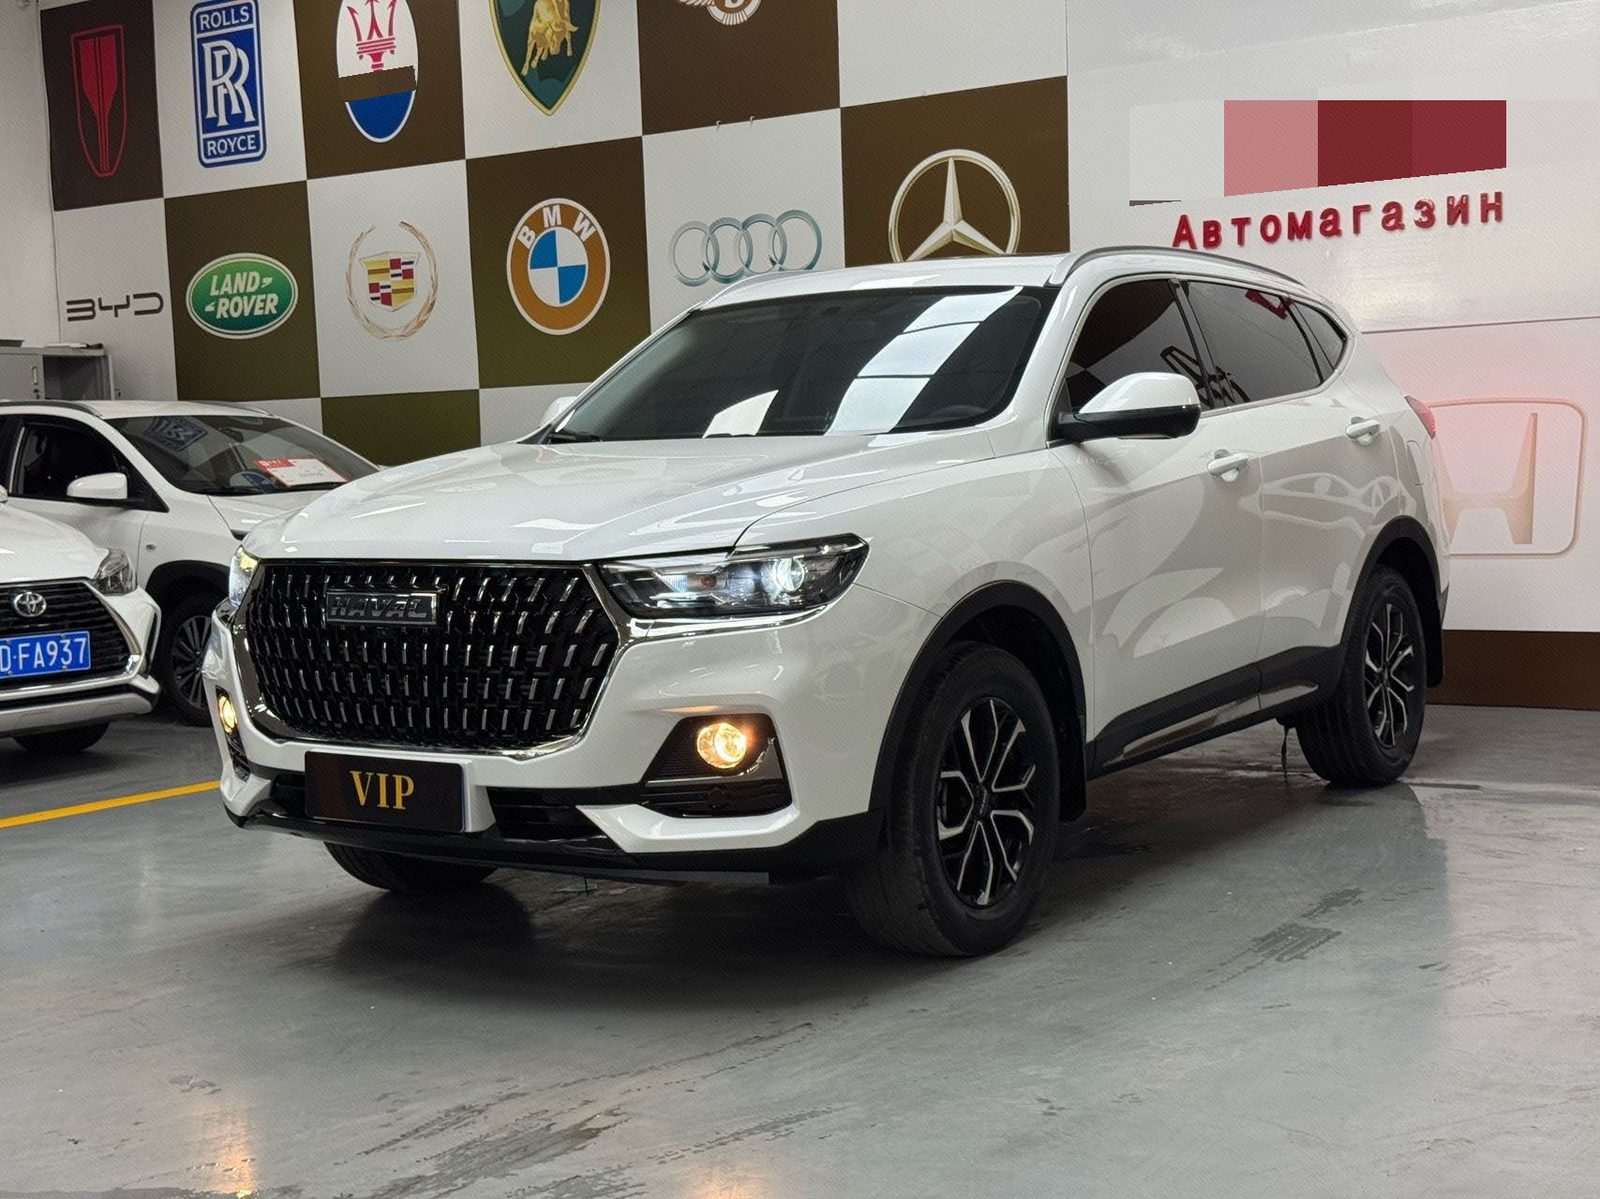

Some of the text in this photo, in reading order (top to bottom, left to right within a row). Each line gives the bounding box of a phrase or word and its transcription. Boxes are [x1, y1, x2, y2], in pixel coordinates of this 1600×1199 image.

[200, 5, 250, 31] ROLLS
[206, 135, 257, 157] ROYCE
[517, 205, 596, 251] BMW
[1172, 191, 1504, 250] Автомагазин
[209, 271, 260, 297] LAND
[66, 292, 164, 322] BYD
[215, 293, 279, 320] ROVER
[331, 597, 427, 618] HAVAL
[350, 770, 415, 810] VIP
